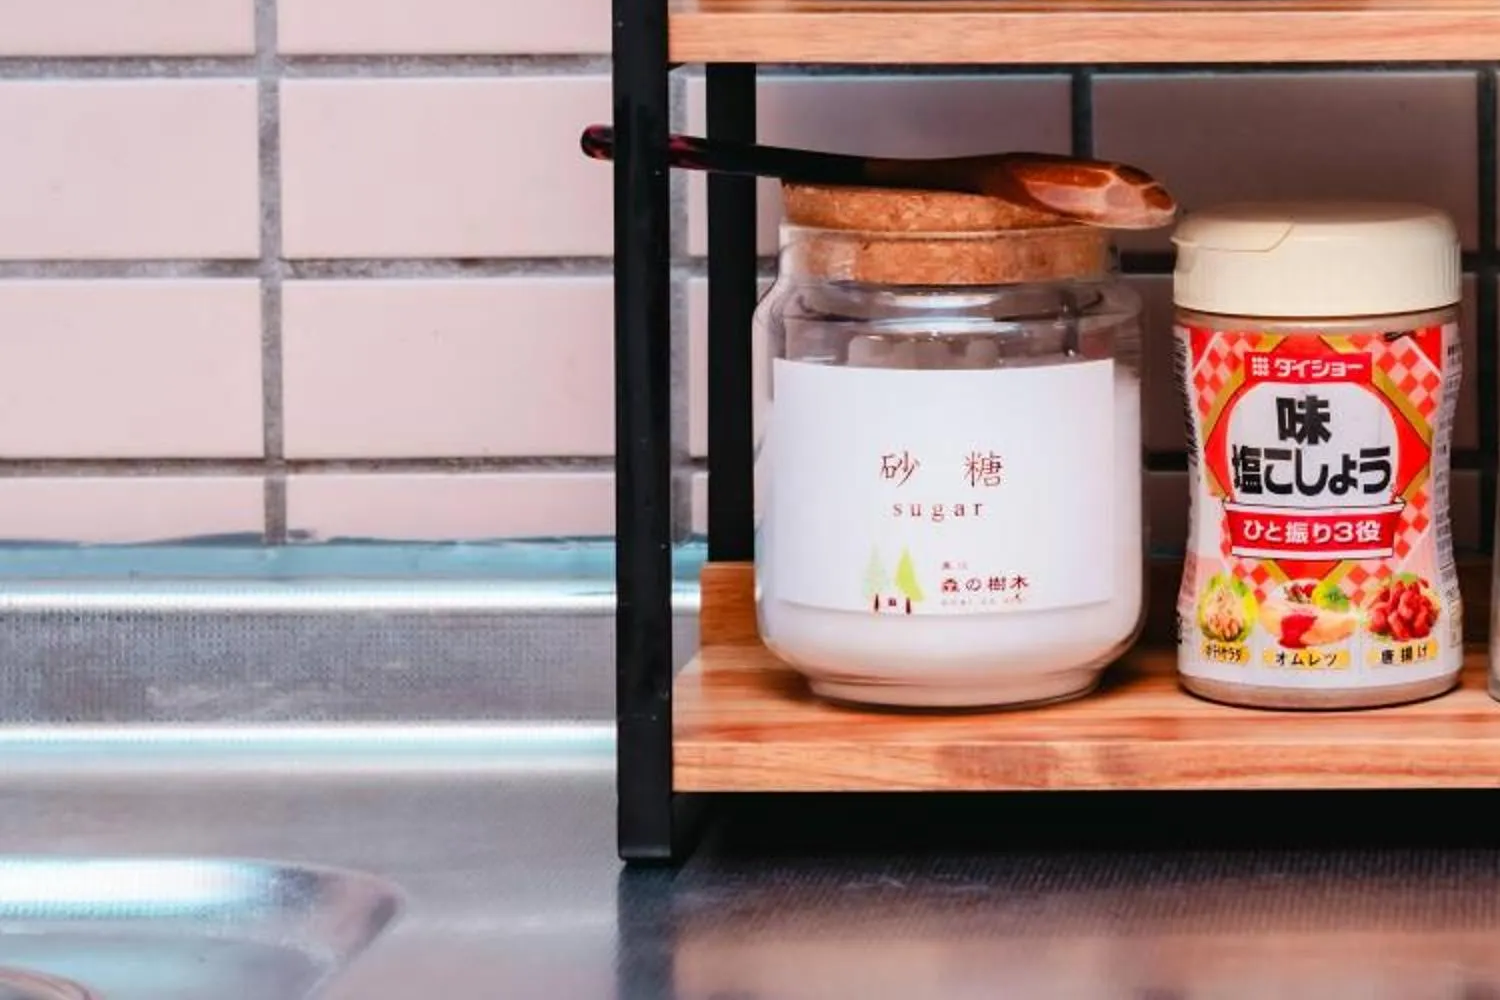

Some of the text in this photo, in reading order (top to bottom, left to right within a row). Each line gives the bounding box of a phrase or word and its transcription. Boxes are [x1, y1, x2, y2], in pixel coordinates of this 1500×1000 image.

[1274, 356, 1364, 379] ダイショー
[1275, 394, 1332, 445] 味
[1231, 444, 1392, 496] 塩こしょう
[893, 502, 984, 523] sugar
[1242, 519, 1382, 545] ひと振り3役
[1275, 650, 1338, 667] オムレツ
